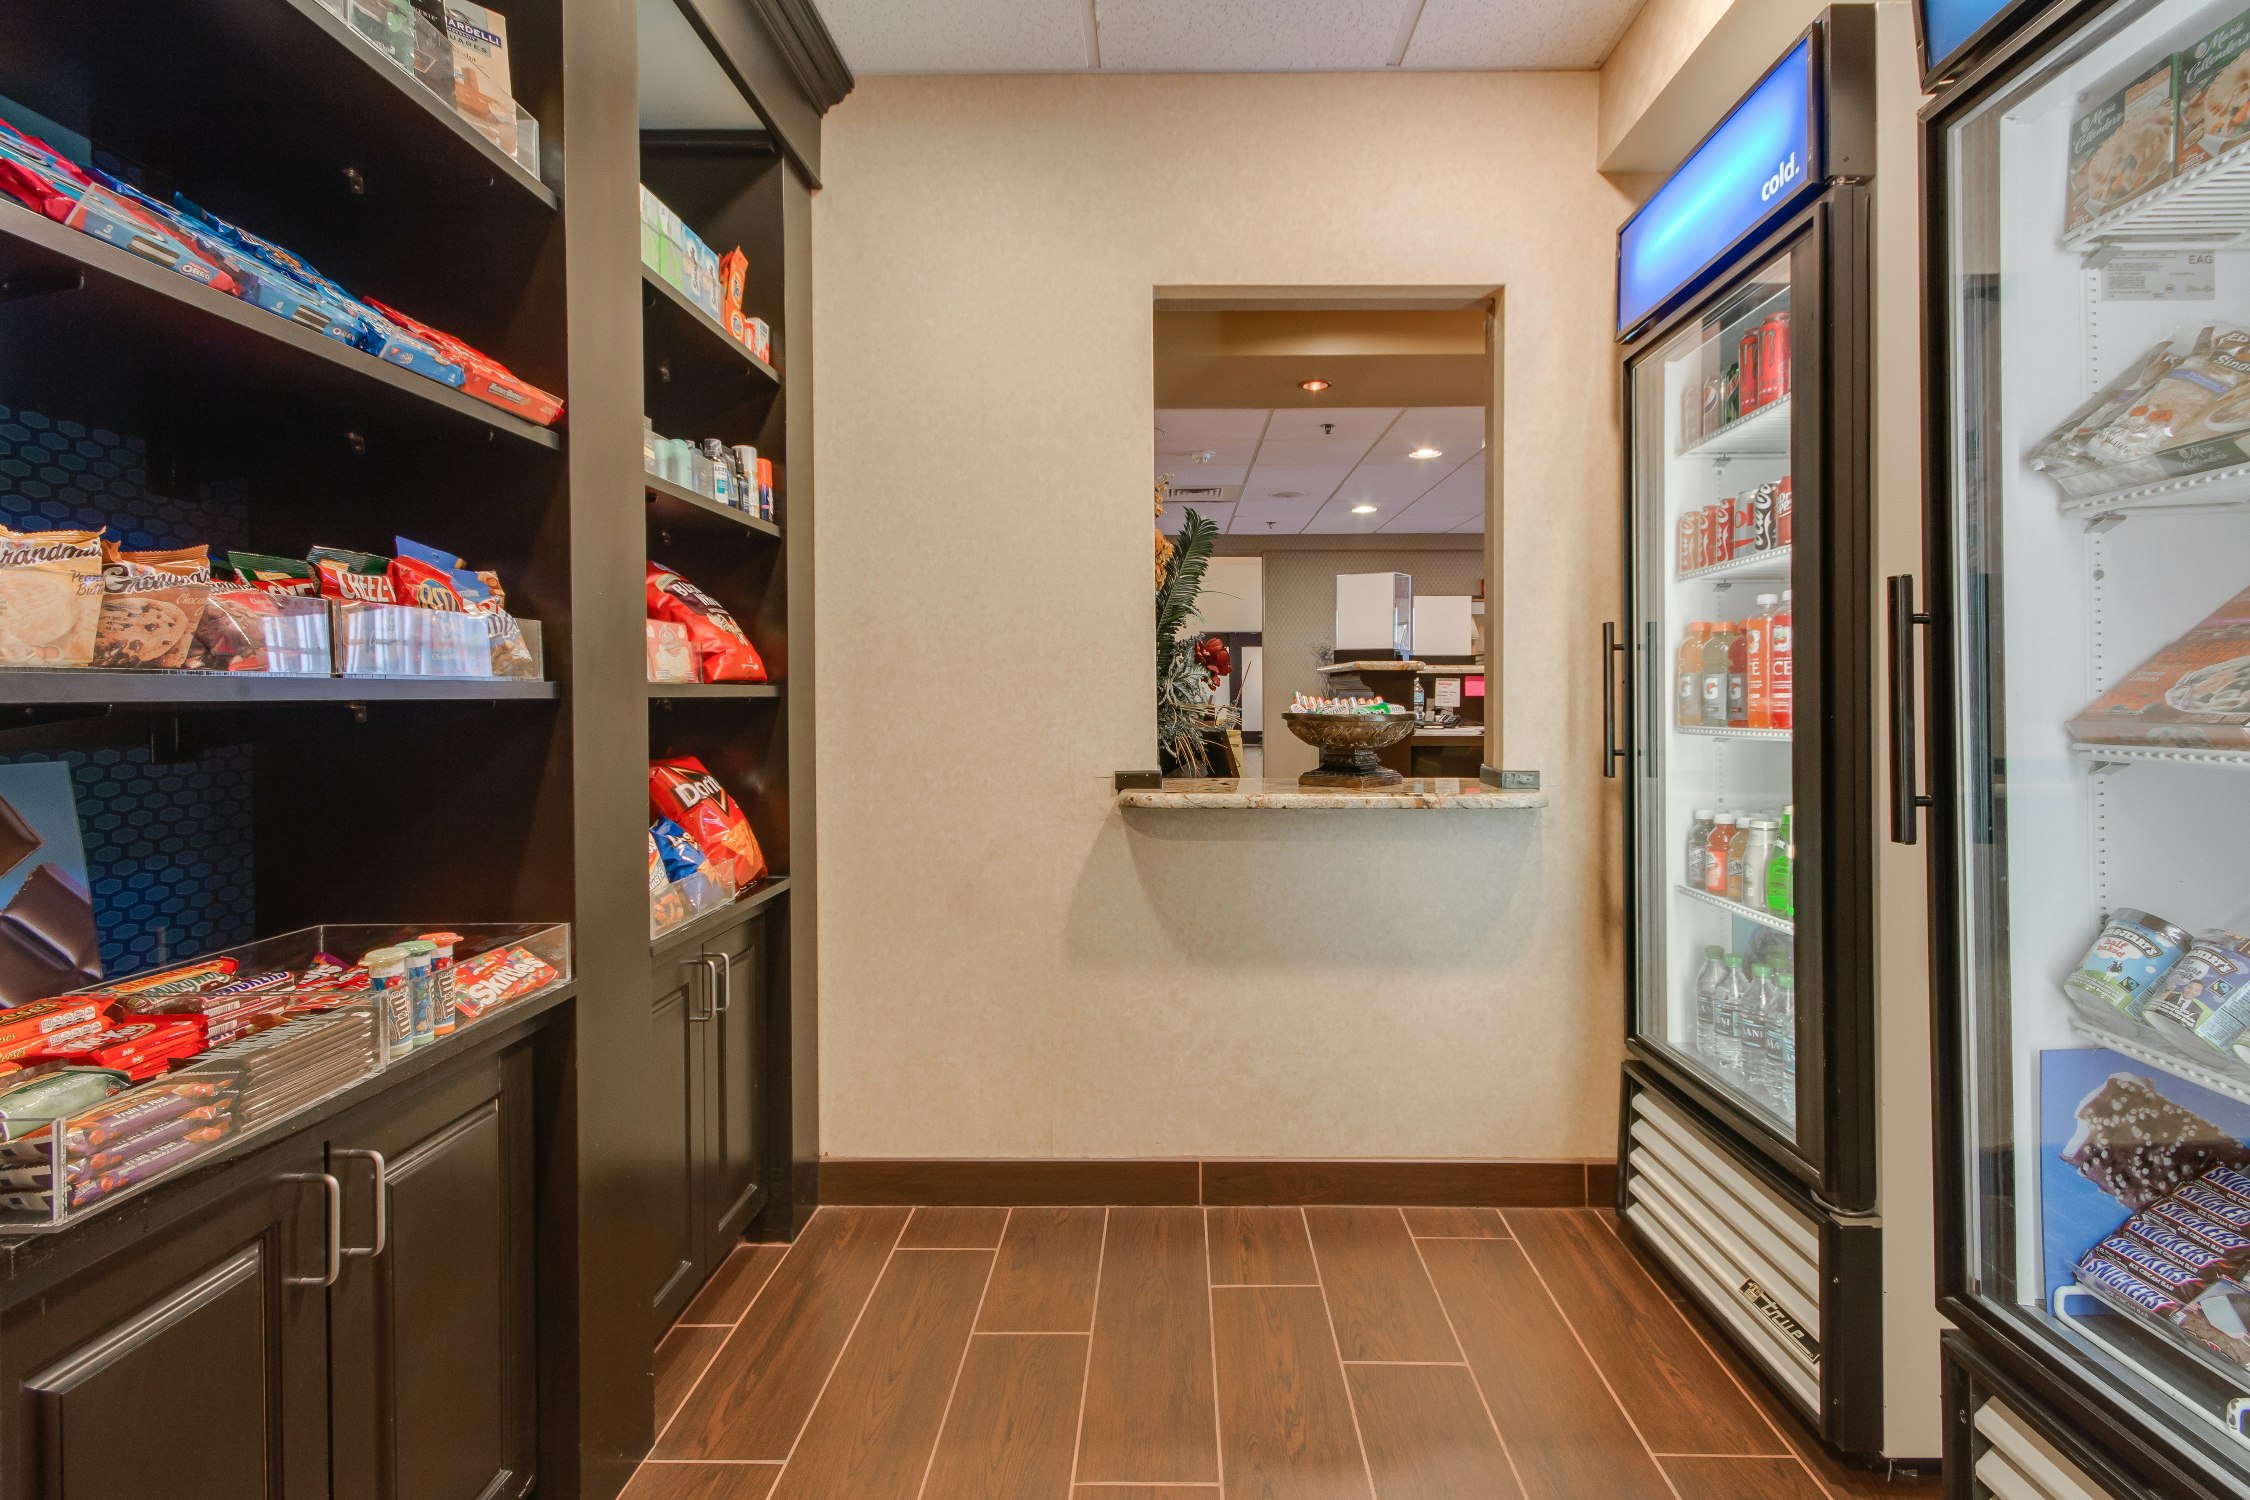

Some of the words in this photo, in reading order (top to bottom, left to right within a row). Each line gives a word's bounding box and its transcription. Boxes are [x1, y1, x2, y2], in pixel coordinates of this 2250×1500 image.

[447, 17, 500, 46] ARDELLI
[449, 34, 488, 54] UARES
[1761, 152, 1799, 201] cold.
[103, 224, 114, 233] 3
[180, 264, 211, 281] OREO
[2189, 256, 2213, 264] EAG
[336, 570, 397, 603] CHEEZ-I
[1774, 660, 1792, 675] CE
[2119, 928, 2158, 956] JERRY'S
[469, 957, 546, 1005] Skittles
[114, 1108, 140, 1119] Fruit
[2155, 1202, 2249, 1246] SNICKERS
[2131, 1221, 2221, 1266] SNICKERS
[2178, 1226, 2188, 1235] ICE
[2188, 1232, 2210, 1247] CREAM
[2210, 1243, 2225, 1255] BAR
[2105, 1239, 2197, 1283] SNICKERS
[2152, 1246, 2162, 1254] ICE
[2162, 1251, 2184, 1267] CREAM
[2184, 1263, 2198, 1273] BAR
[2086, 1259, 2171, 1309] SNICKERS
[2128, 1262, 2139, 1271] ICE
[2139, 1268, 2160, 1284] CREAM
[2160, 1281, 2175, 1291] BAR
